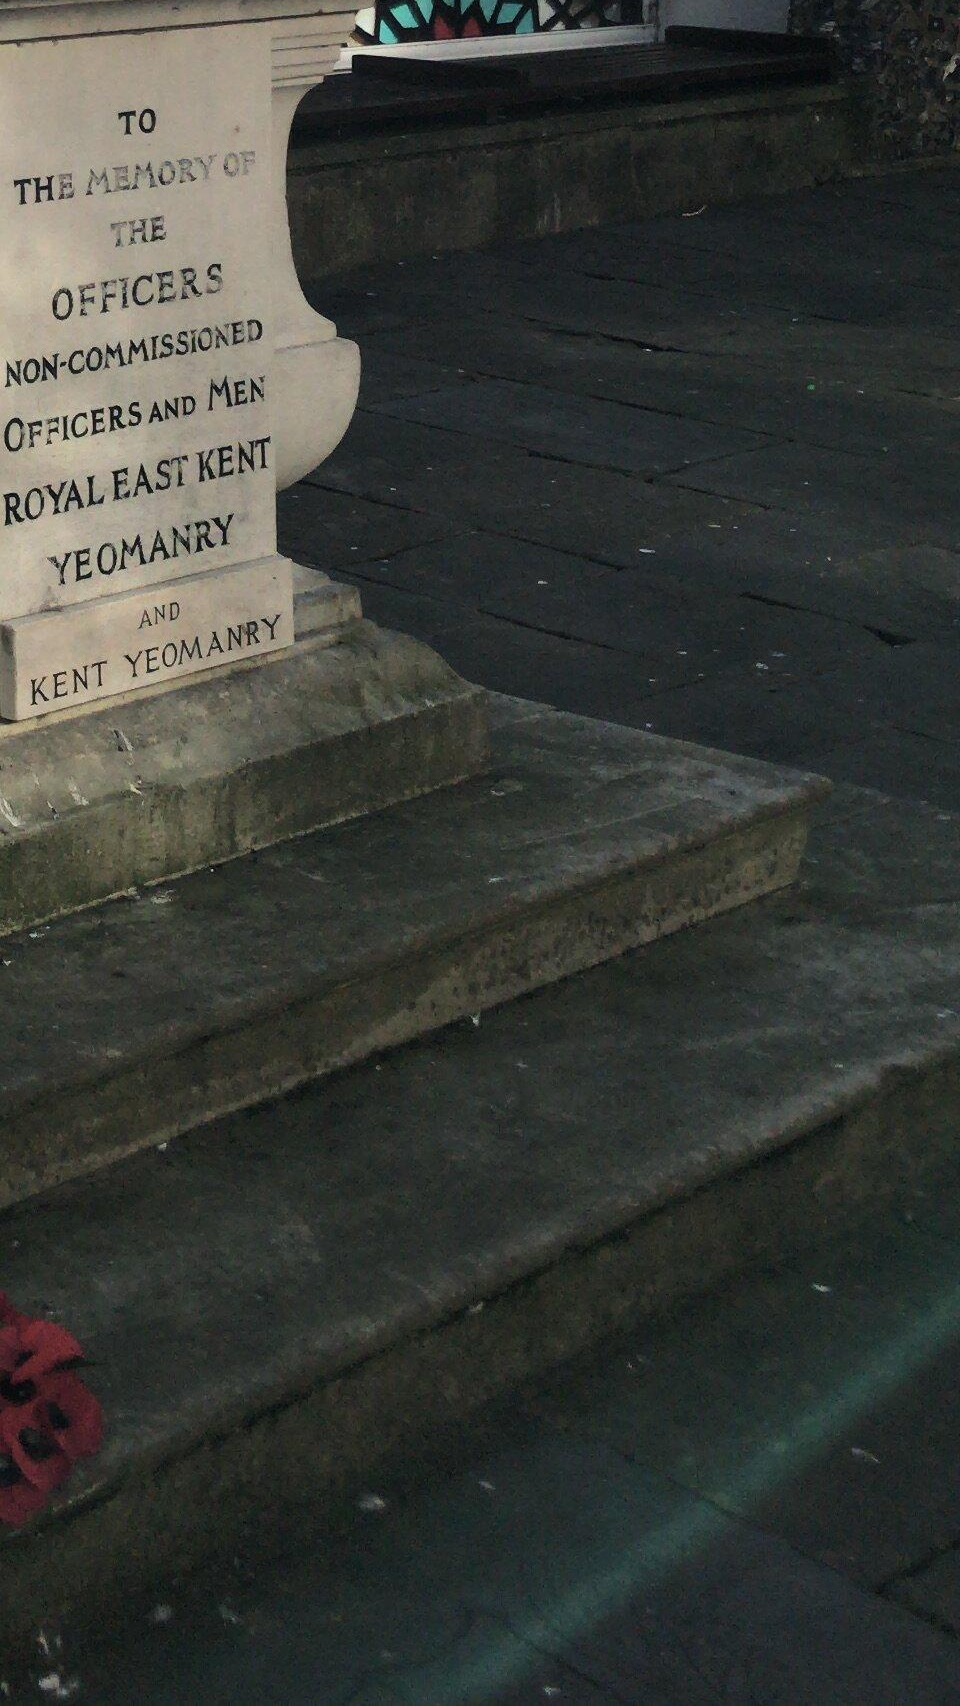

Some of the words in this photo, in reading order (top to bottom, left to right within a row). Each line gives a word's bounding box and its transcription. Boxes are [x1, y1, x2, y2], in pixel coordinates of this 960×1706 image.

[118, 109, 156, 135] TO
[13, 172, 75, 205] THE
[85, 154, 217, 196] MEMORY
[223, 151, 256, 177] OF
[110, 215, 167, 247] THE
[52, 263, 224, 320] OFFICERS
[4, 319, 263, 387] NON-COMMISSIONED
[4, 402, 141, 452] OFFICERS
[148, 395, 196, 423] AND
[208, 376, 266, 411] MEN
[3, 475, 105, 526] ROYAL
[112, 455, 188, 501] EAST
[197, 436, 271, 483] KENT
[47, 513, 235, 585] YEOMANRY
[137, 601, 180, 629] AND
[29, 660, 108, 705] KENT
[123, 614, 282, 678] YEOMANRY
